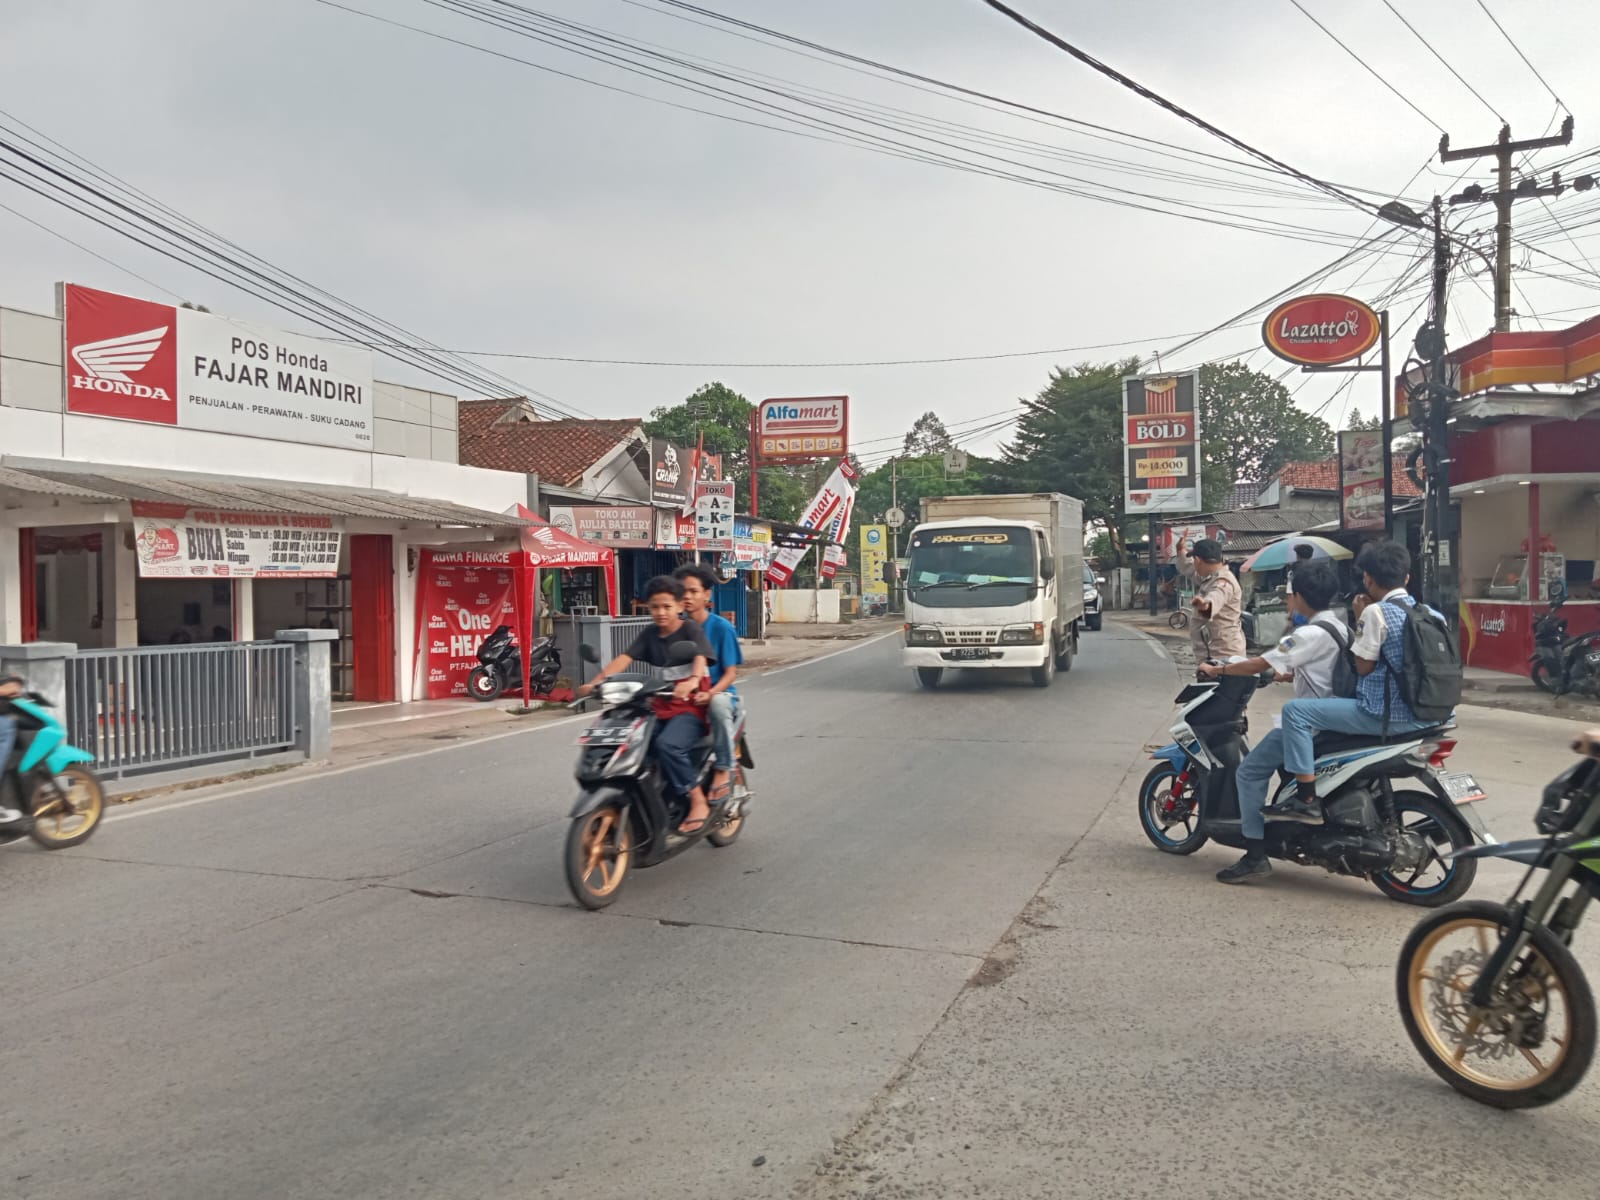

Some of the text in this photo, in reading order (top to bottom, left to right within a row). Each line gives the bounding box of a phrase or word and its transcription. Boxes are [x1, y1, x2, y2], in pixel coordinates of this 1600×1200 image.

[1281, 318, 1348, 338] Lazatto
[232, 336, 328, 372] POS Honda
[72, 375, 172, 401] HONDA
[194, 356, 361, 404] FAJAR MANDIRI
[189, 395, 243, 411] PENJUALAN
[252, 405, 302, 420] PERAWATAN
[310, 414, 331, 424] SUKU
[334, 418, 366, 429] CADANG
[766, 404, 838, 420] Alfamart
[1137, 424, 1186, 440] BOLD
[705, 486, 726, 494] TOKO
[594, 510, 636, 518] TOKO AKI
[580, 520, 650, 530] AULIA BATTERY
[186, 528, 224, 560] BUKA
[466, 552, 510, 563] FINANCE
[568, 552, 598, 562] MANDIRI
[458, 608, 491, 630] One
